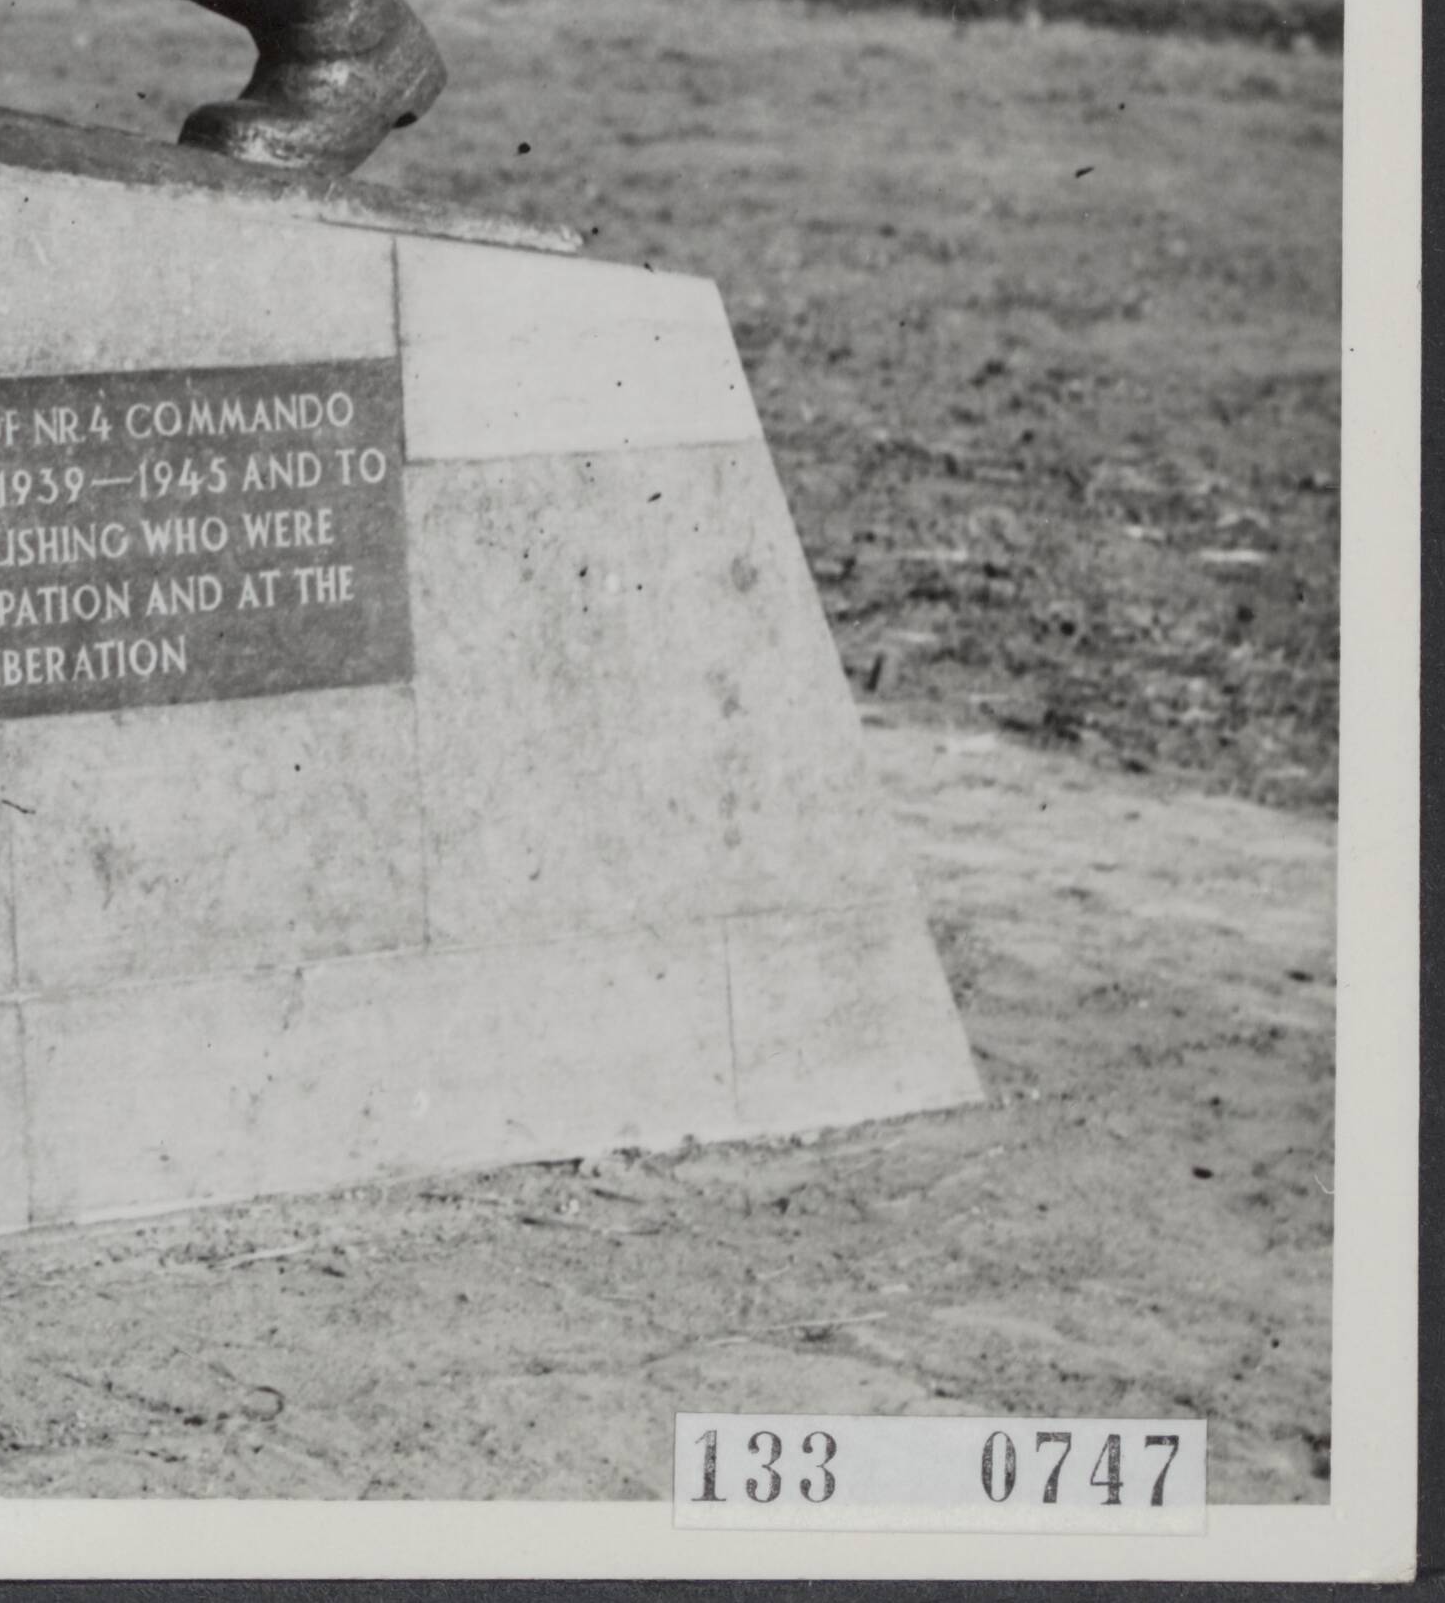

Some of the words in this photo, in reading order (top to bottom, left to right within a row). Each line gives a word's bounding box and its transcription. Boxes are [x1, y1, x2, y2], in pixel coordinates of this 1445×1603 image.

[126, 392, 354, 439] COMMANDO
[242, 451, 322, 492] AND
[335, 448, 386, 486] TO
[141, 516, 228, 556] WHO
[241, 508, 334, 548] WERE
[146, 575, 222, 617] AND
[238, 570, 281, 609] AT
[294, 565, 355, 605] THE
